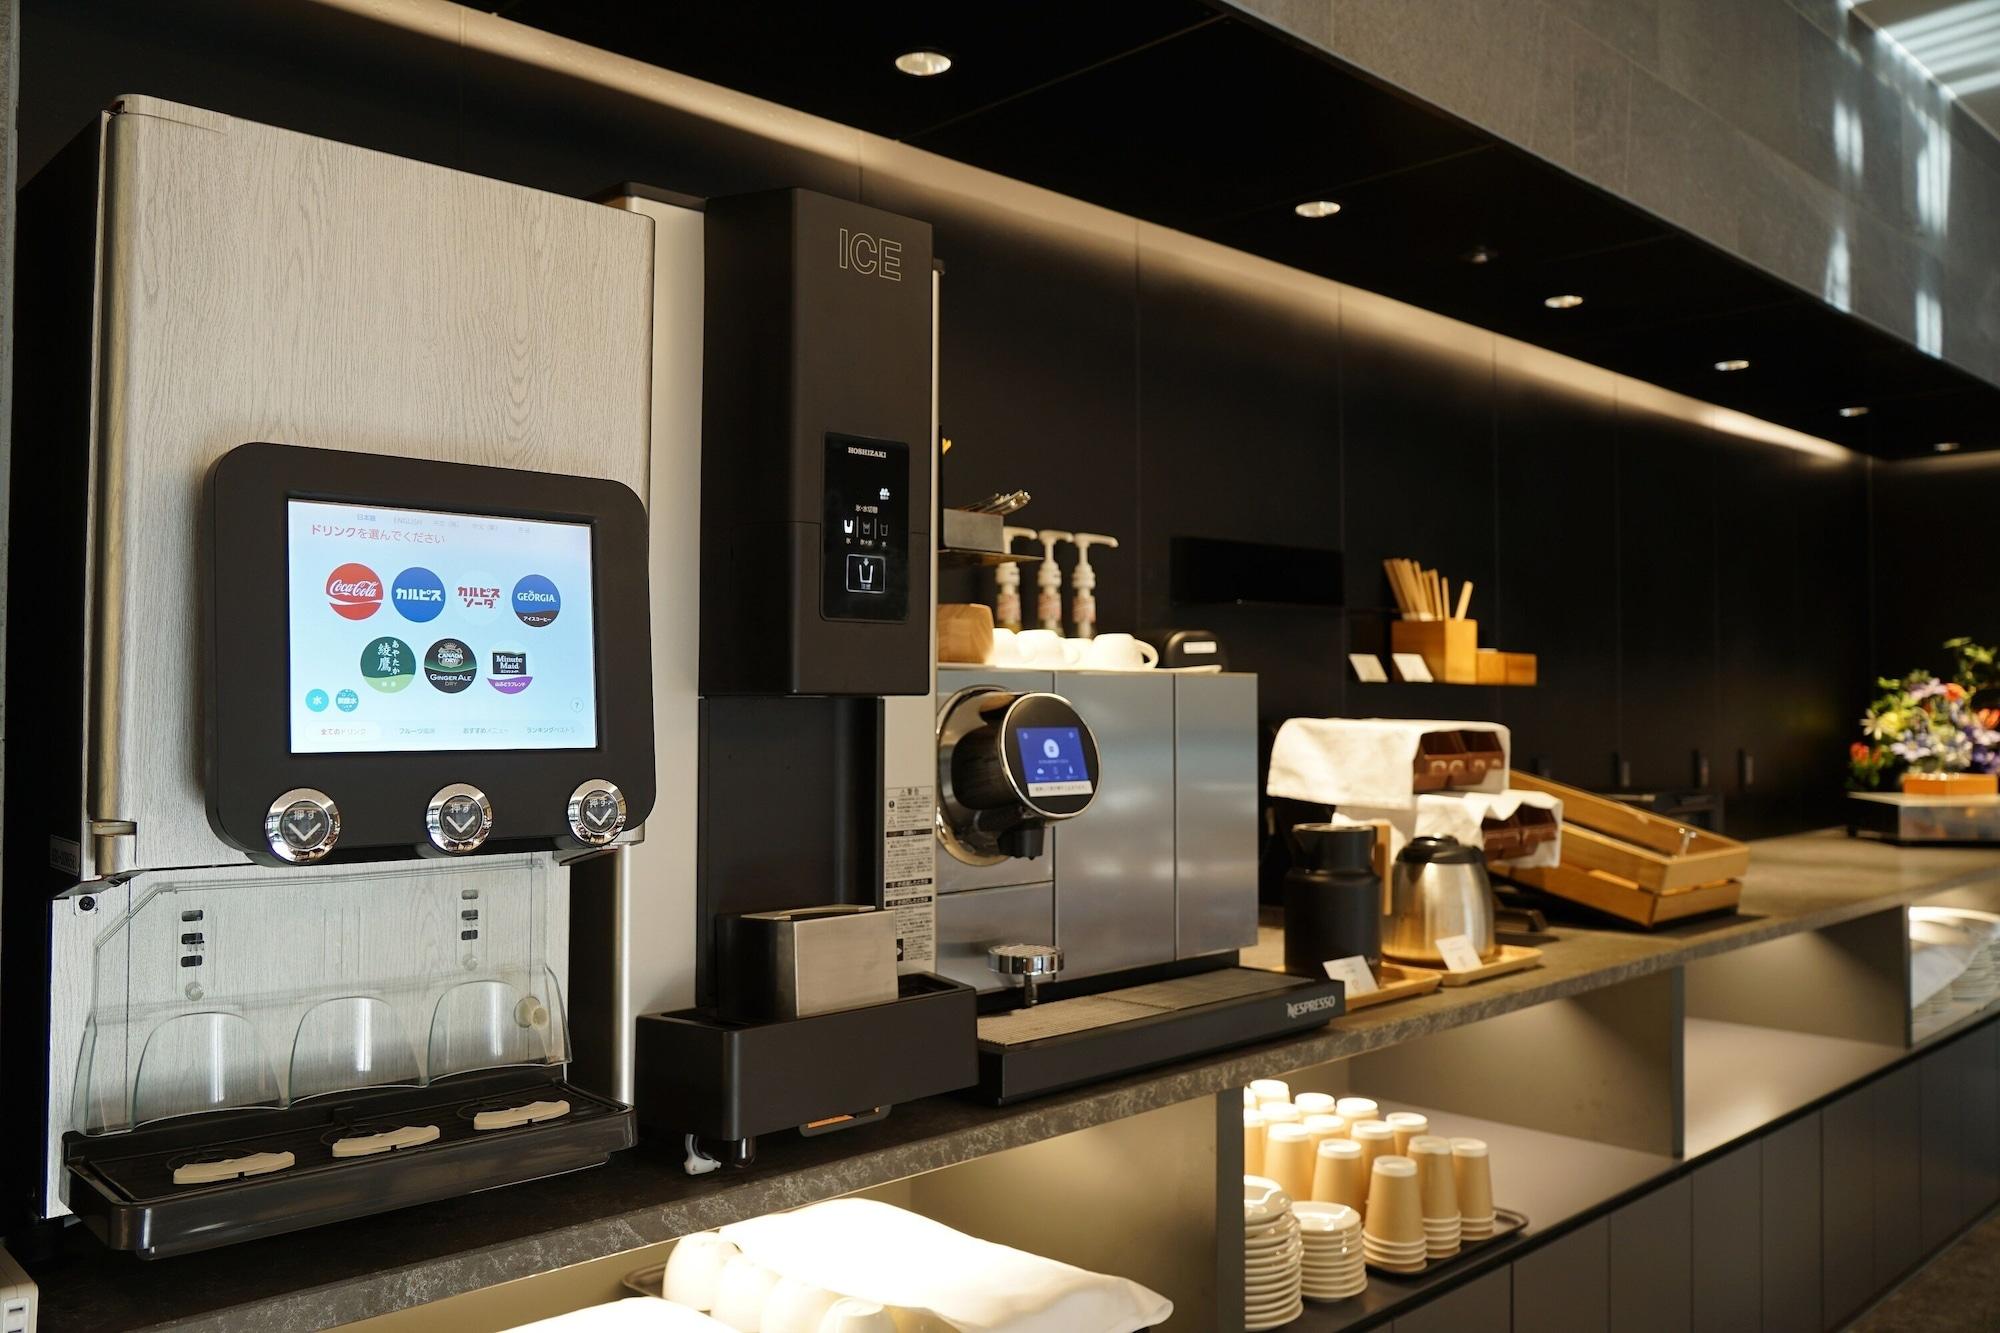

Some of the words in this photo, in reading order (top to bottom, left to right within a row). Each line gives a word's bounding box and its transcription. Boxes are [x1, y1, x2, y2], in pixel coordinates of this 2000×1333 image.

[839, 227, 902, 282] ICE
[847, 446, 887, 459] HOSHIZAKI
[311, 523, 446, 545] ドリンクを選んでください
[329, 579, 379, 598] Coca-Cola
[395, 587, 442, 602] カルピス
[457, 585, 501, 599] カルピス
[463, 597, 497, 609] ソーダ
[523, 615, 552, 623] アイスコーヒー
[437, 652, 464, 660] CANADA
[496, 654, 523, 664] Minute
[500, 661, 520, 670] Maid
[429, 673, 458, 682] GINGER
[458, 674, 472, 682] ALE
[293, 809, 317, 821] 押す
[1286, 995, 1336, 1018] NESPRESSO
